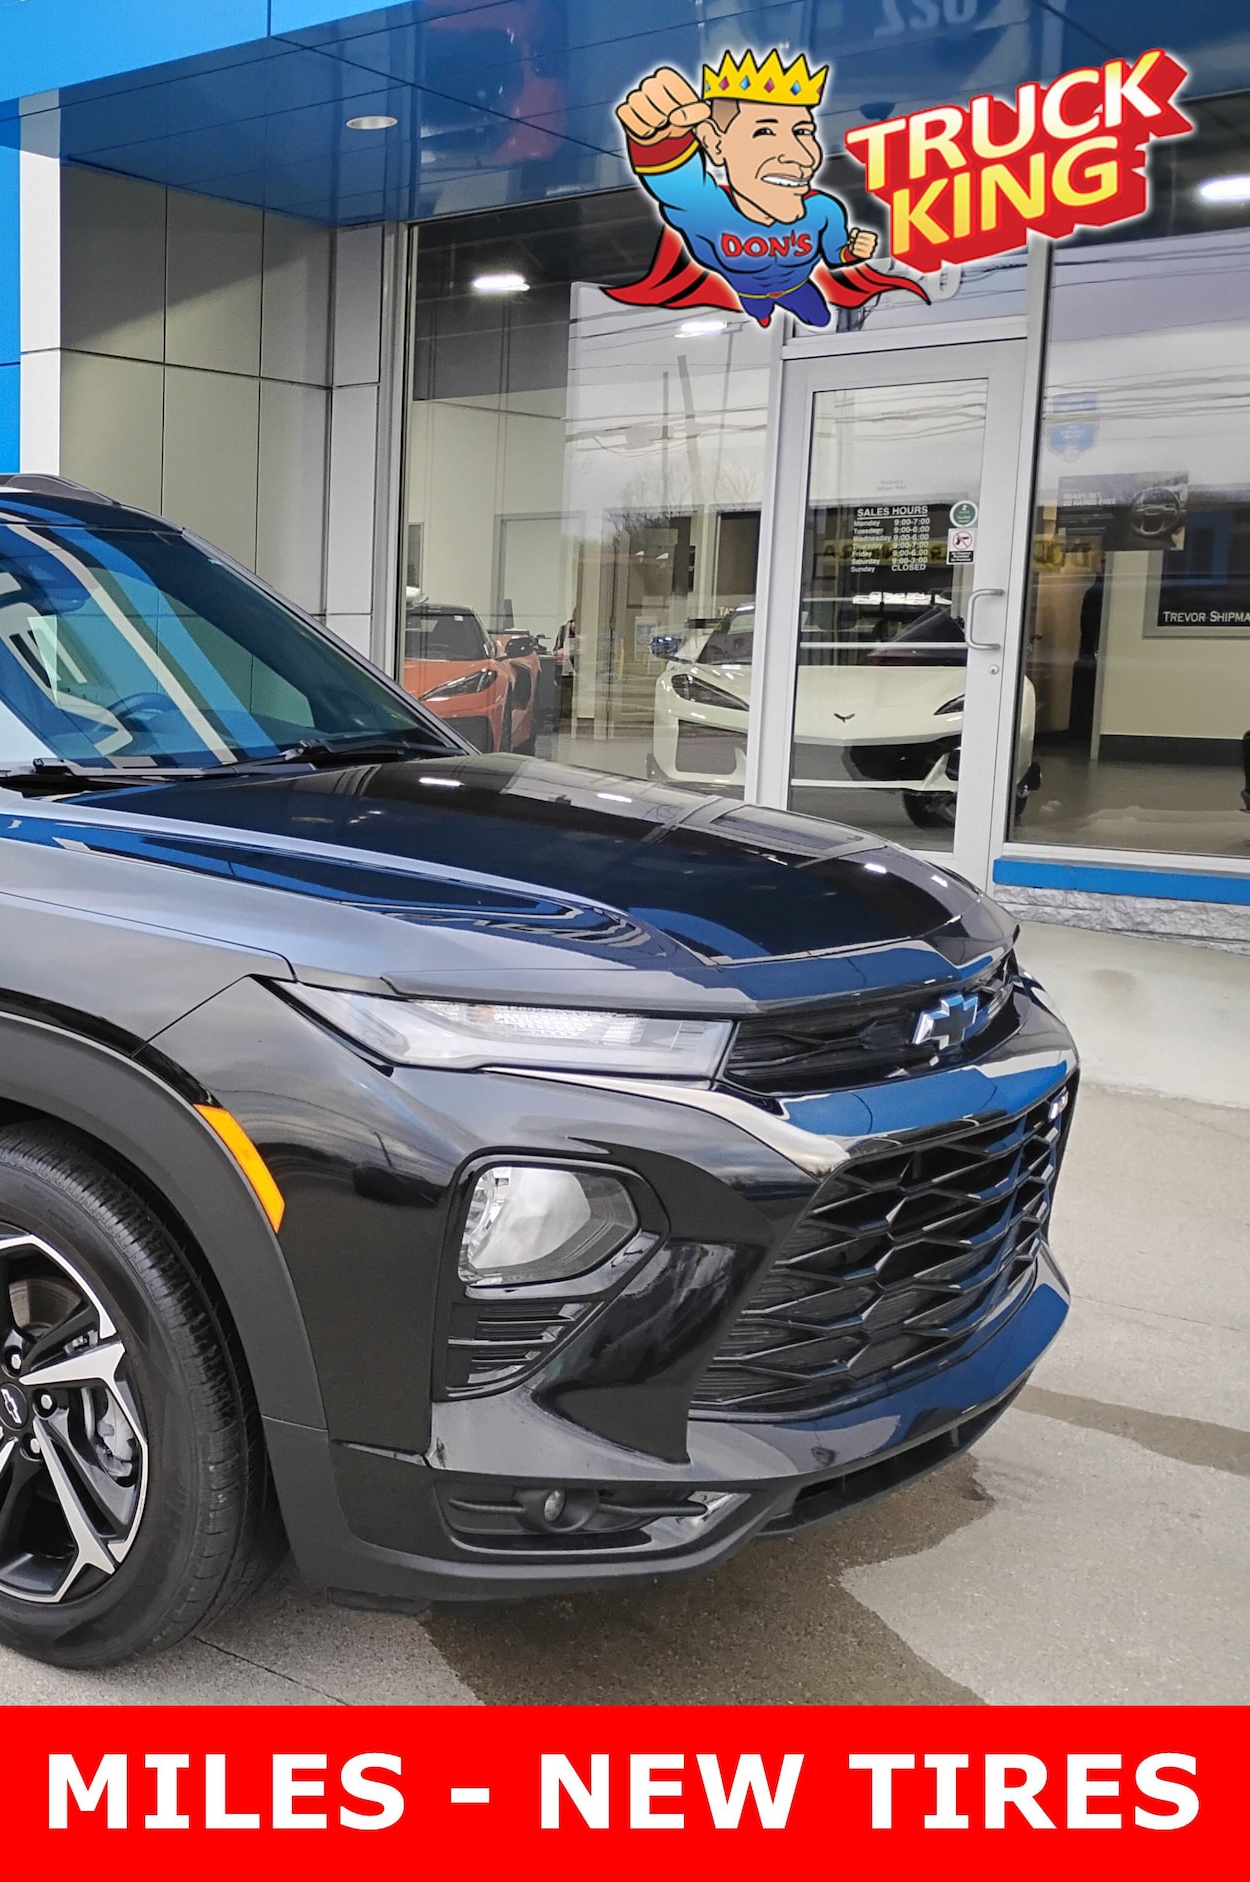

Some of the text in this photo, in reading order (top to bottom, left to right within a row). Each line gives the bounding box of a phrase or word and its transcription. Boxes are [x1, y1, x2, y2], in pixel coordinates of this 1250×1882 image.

[857, 505, 928, 517] SALES HOURS
[853, 518, 930, 528] Monday 9:00-7:00
[893, 541, 929, 549] 9:00-7:00
[851, 550, 873, 558] Friday
[851, 558, 881, 566] Saturday
[891, 563, 927, 572] CLOSED
[1162, 611, 1206, 623] TREVOR
